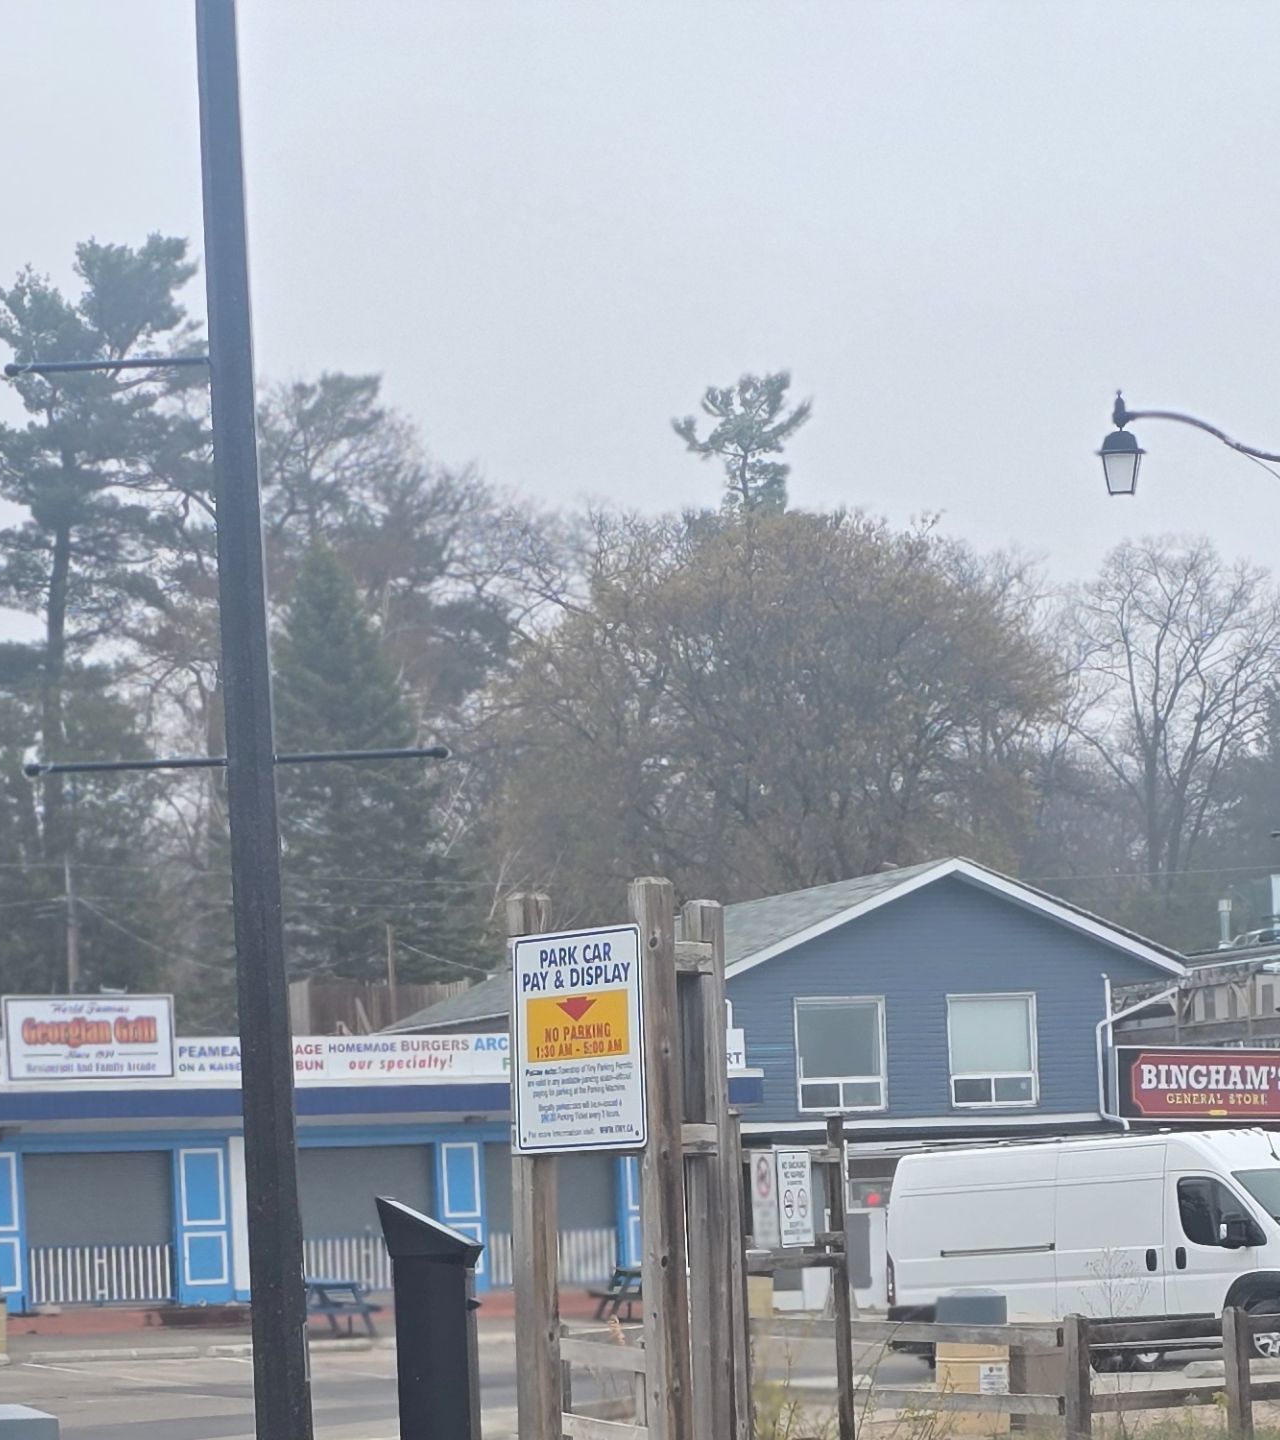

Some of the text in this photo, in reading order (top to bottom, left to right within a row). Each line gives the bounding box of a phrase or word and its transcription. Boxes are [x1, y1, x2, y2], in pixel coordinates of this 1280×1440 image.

[540, 943, 611, 969] PARK CAR
[523, 962, 630, 992] PAY & DISPLAY
[22, 1016, 158, 1048] Georgian Grill
[545, 1022, 611, 1043] NO PARKING
[295, 1044, 322, 1055] AGE
[328, 1039, 470, 1053] HOMEMADE BURGERS
[474, 1037, 508, 1052] ARC
[536, 1045, 555, 1058] 1:30
[558, 1043, 572, 1056] AM
[607, 1039, 622, 1052] AM
[179, 1046, 241, 1058] PEAMEA
[726, 1052, 742, 1064] RT
[179, 1062, 241, 1072] ON A KAISE
[296, 1060, 324, 1071] BUN
[349, 1054, 453, 1072] our specialty!
[1166, 1093, 1224, 1105] GENERAL
